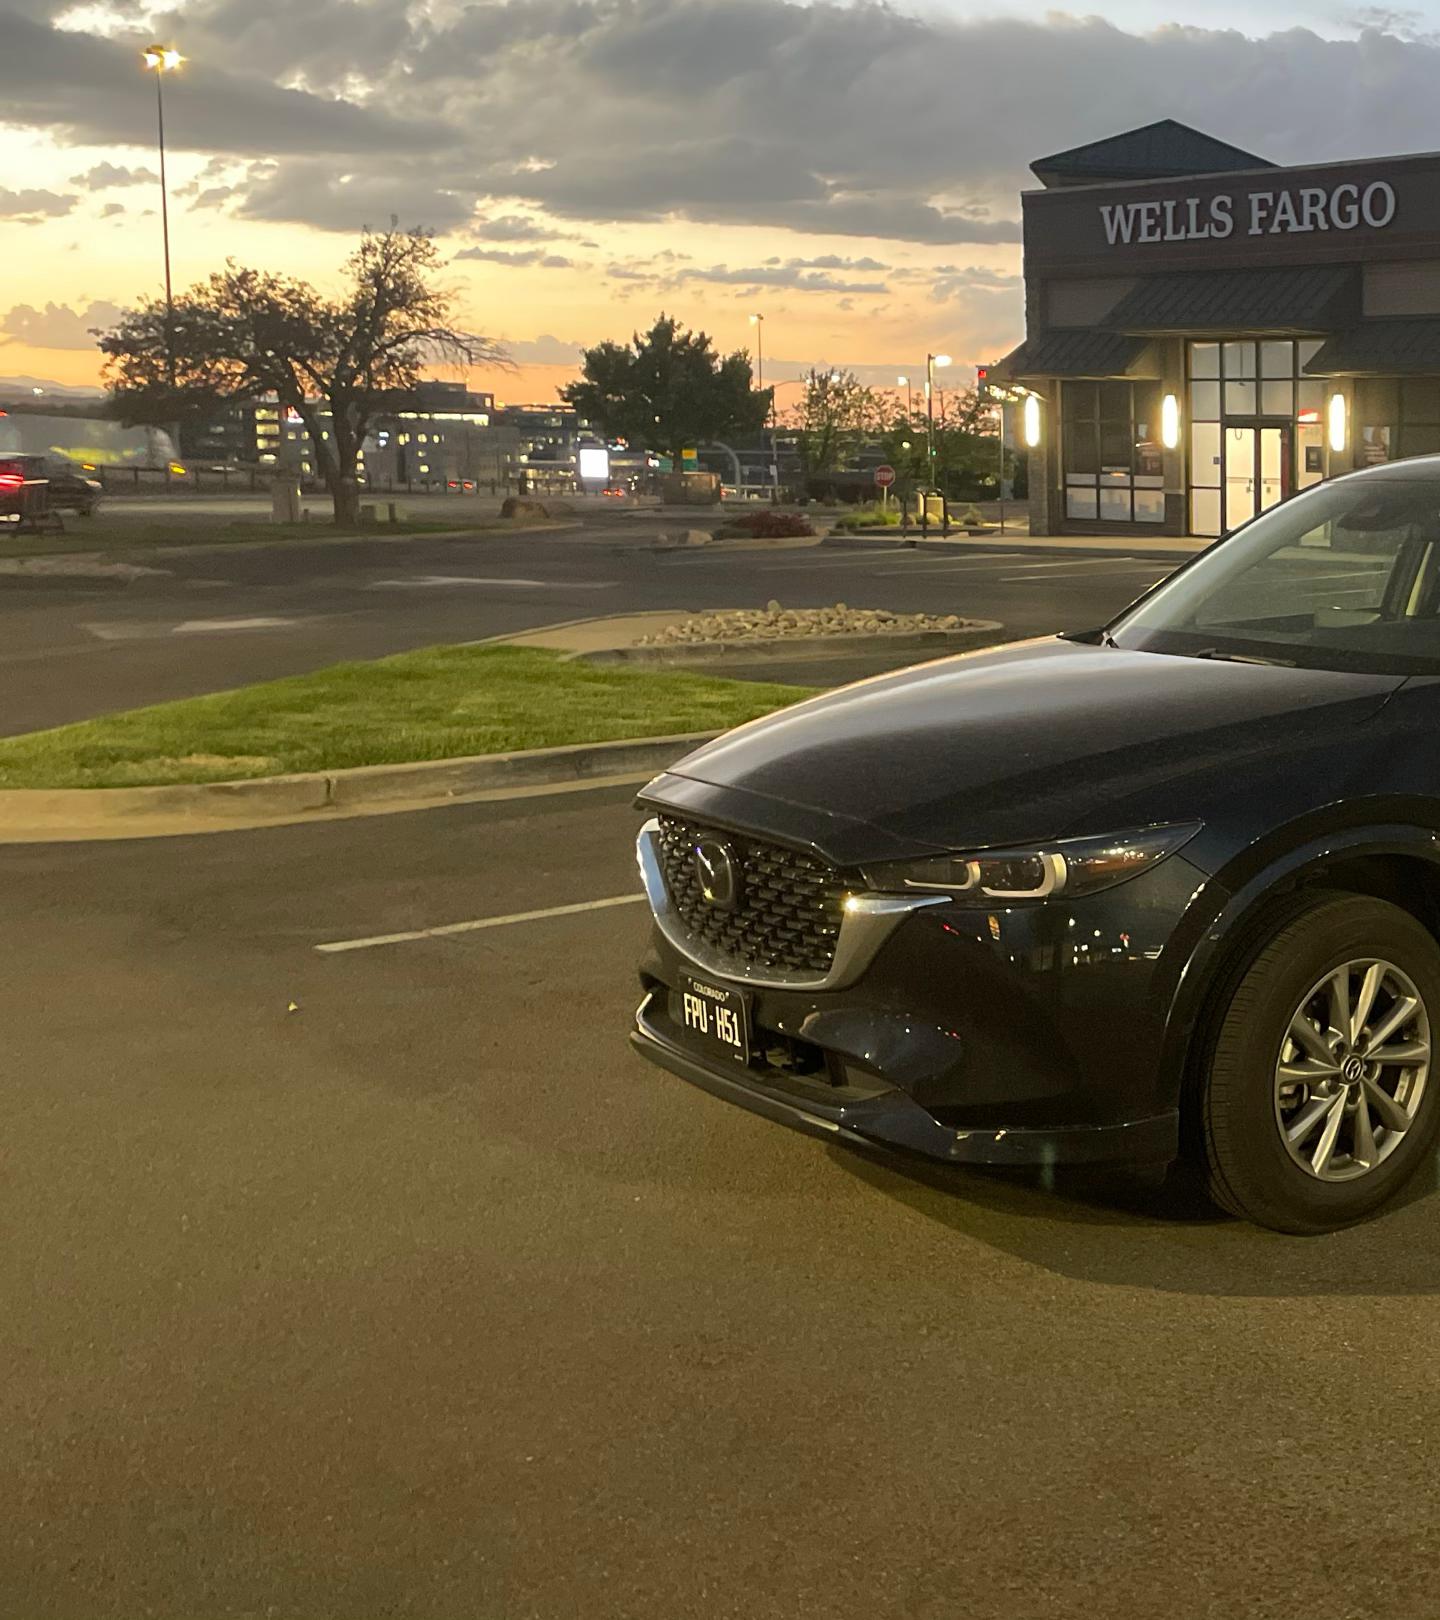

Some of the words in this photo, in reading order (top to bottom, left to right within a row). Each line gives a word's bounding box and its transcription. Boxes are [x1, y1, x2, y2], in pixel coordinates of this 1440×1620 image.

[1100, 195, 1234, 245] WELLS
[1248, 181, 1396, 235] FARGO
[876, 472, 893, 481] STOP
[693, 982, 725, 1002] COLORADO
